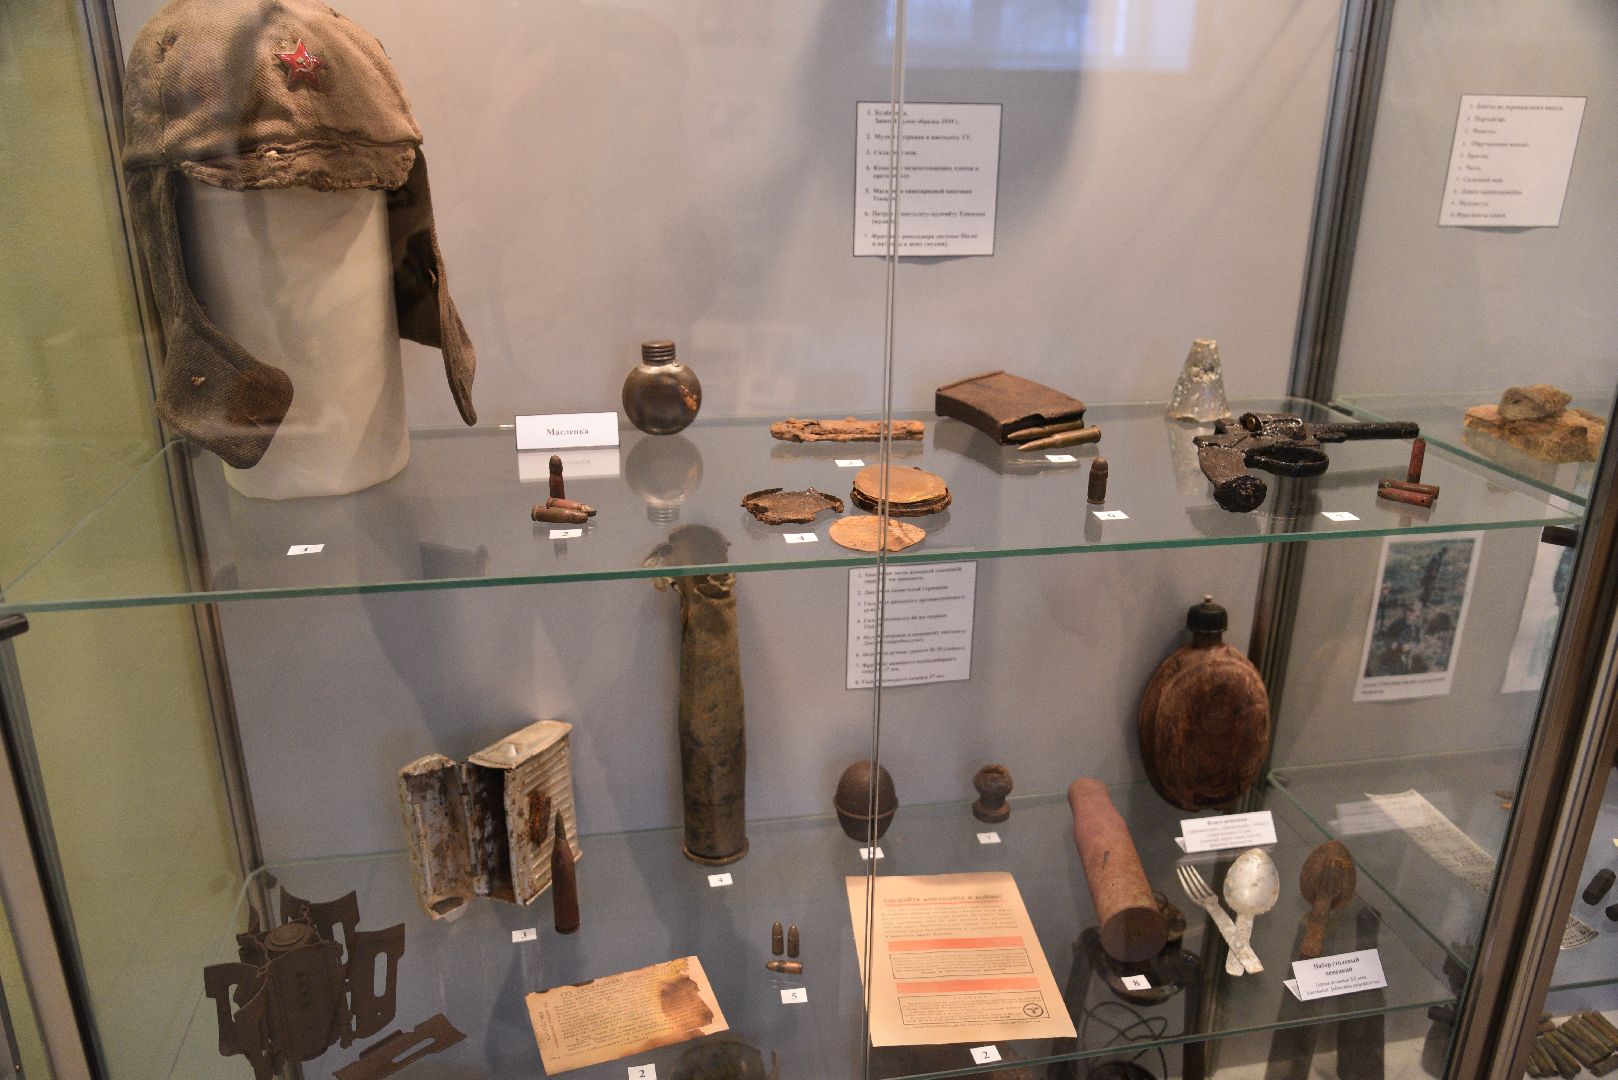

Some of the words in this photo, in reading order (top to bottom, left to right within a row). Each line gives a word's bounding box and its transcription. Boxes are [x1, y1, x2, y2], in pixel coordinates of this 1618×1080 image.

[791, 992, 798, 1000] 5
[982, 1051, 990, 1059] 2
[638, 1069, 646, 1078] 2
